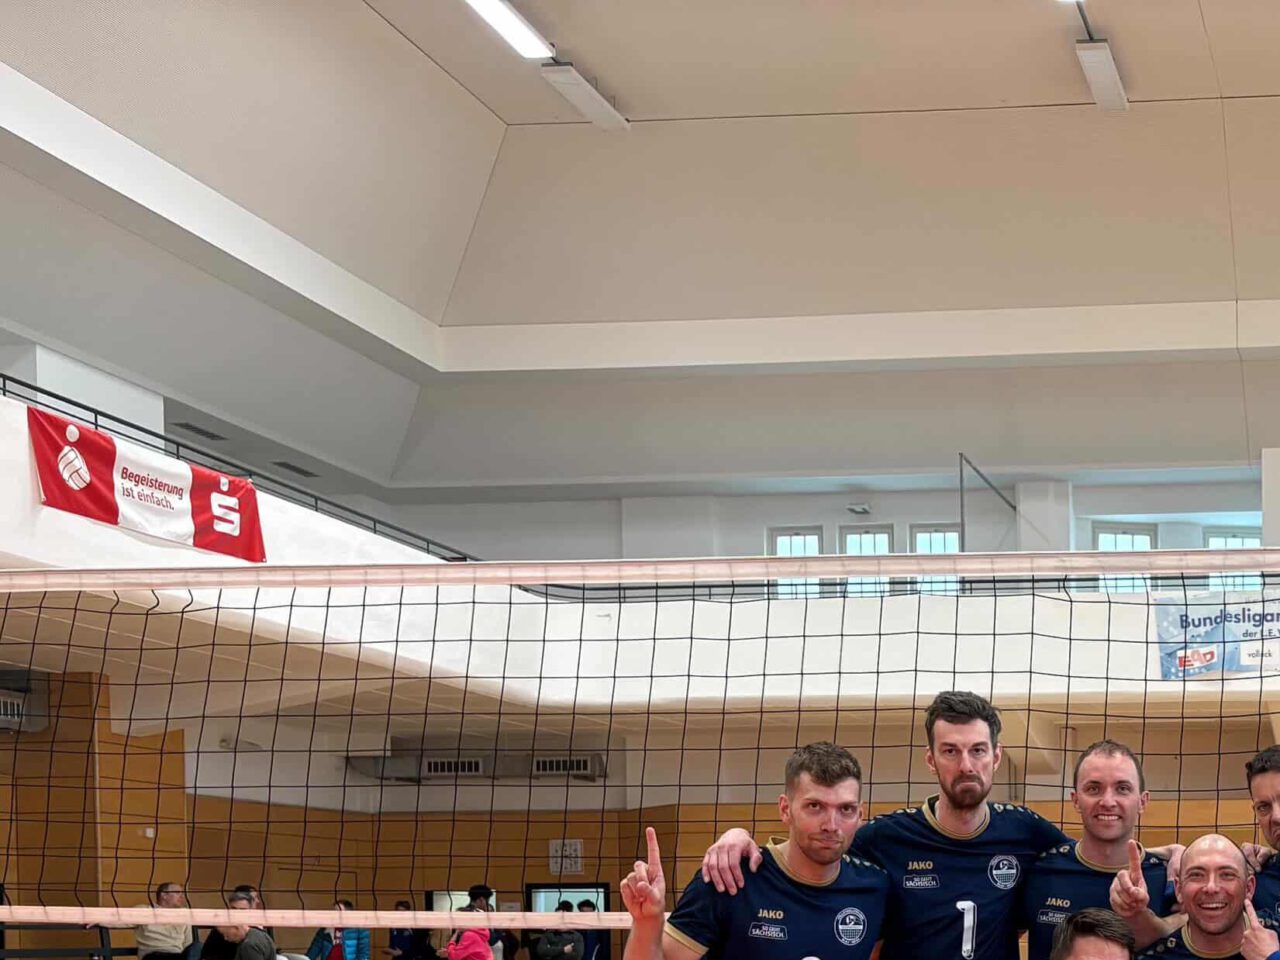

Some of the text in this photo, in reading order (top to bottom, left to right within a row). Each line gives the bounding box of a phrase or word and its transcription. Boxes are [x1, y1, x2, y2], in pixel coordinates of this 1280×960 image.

[121, 466, 184, 500] Begeisterung
[121, 482, 175, 511] ist einfach.
[1242, 629, 1258, 638] der
[907, 860, 934, 871] JAKO
[1045, 897, 1071, 908] JAKO
[757, 908, 785, 920] JAKO
[956, 900, 977, 960] 1
